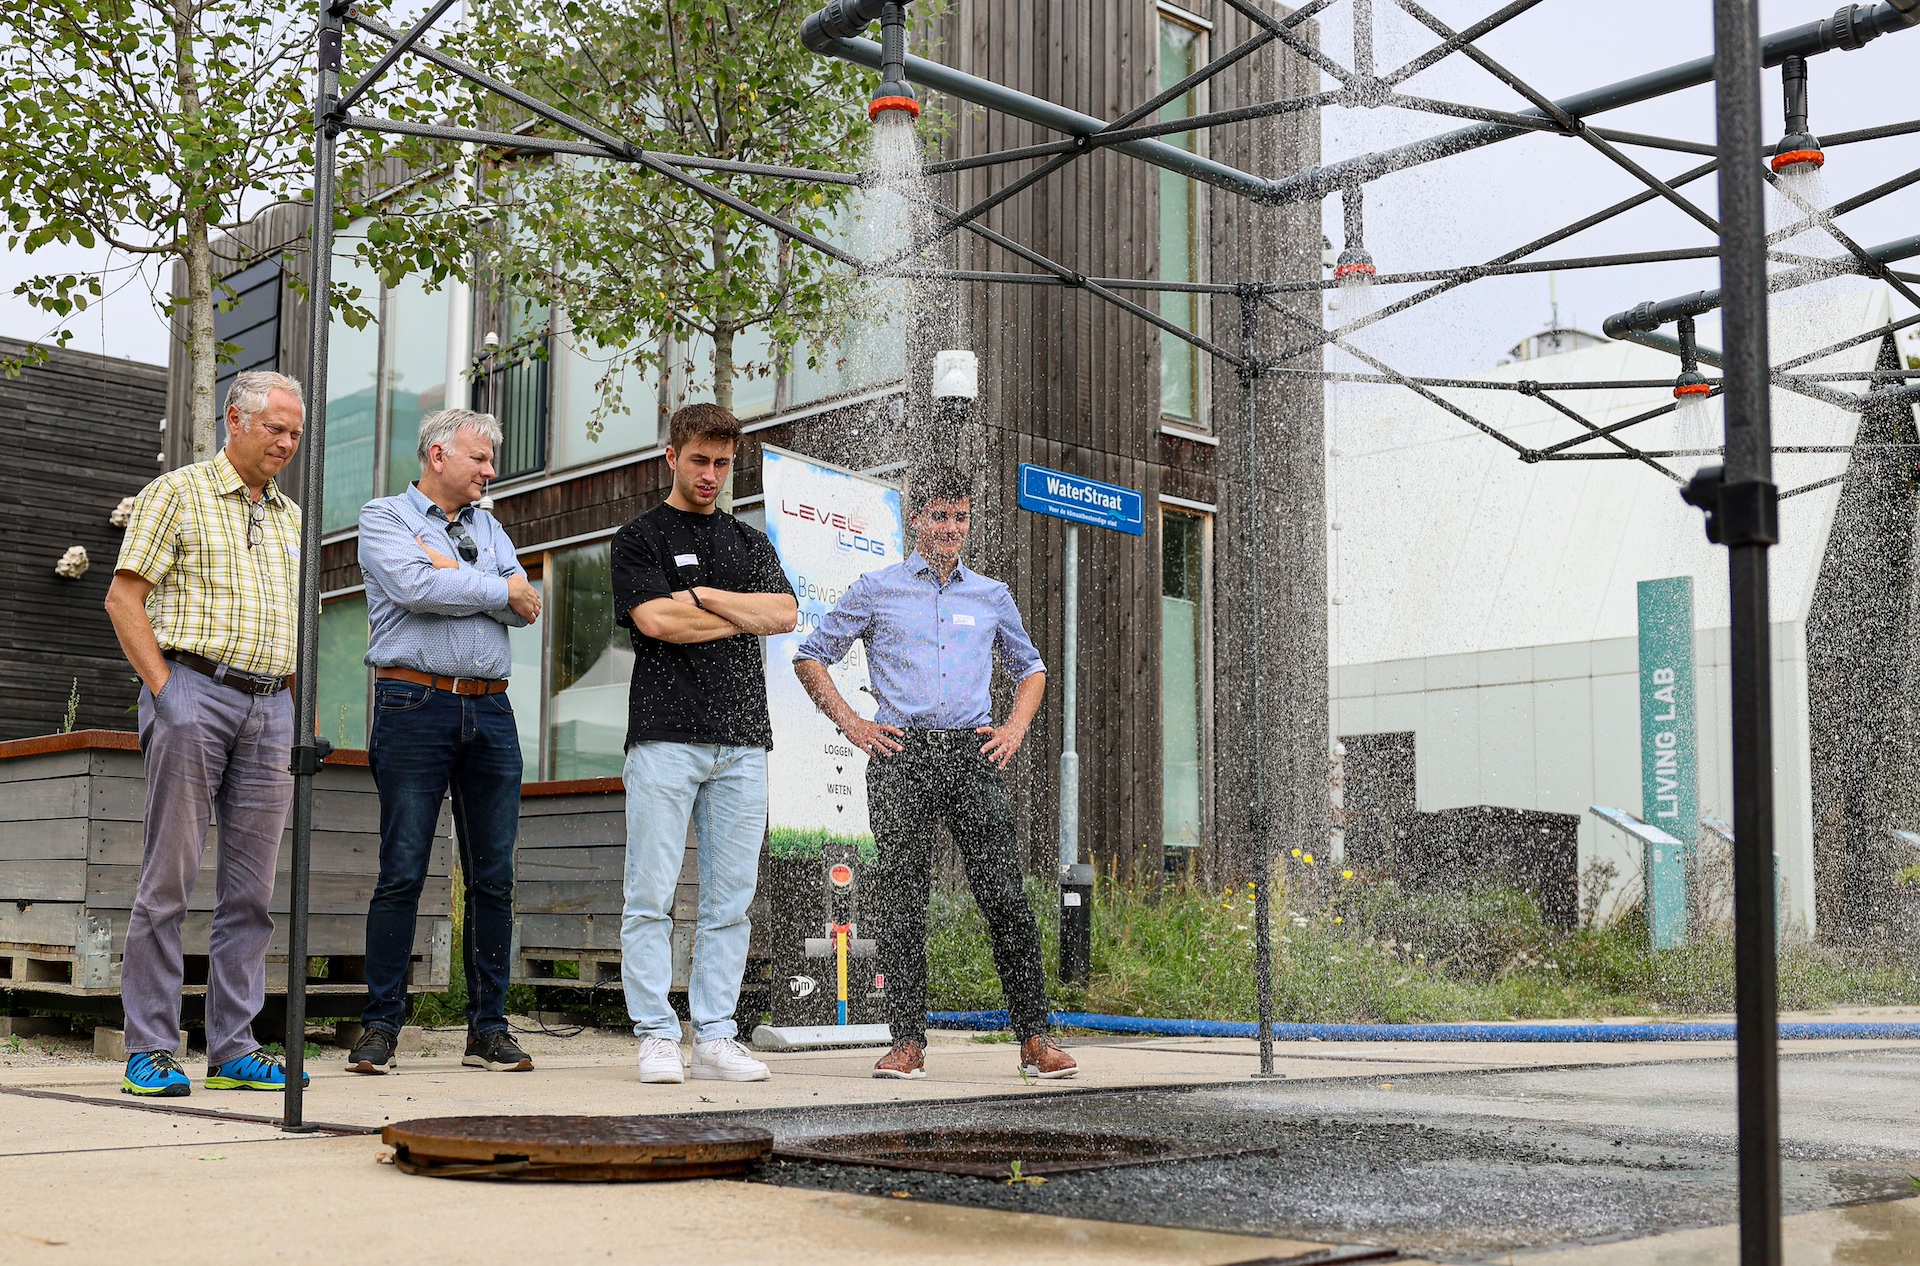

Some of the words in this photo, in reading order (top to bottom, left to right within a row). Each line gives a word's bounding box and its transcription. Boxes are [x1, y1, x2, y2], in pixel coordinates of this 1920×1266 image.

[1046, 476, 1122, 511] WaterStraat
[782, 499, 863, 535] LEVEL
[837, 531, 885, 557] LOG
[1653, 667, 1676, 721] LAB
[824, 744, 854, 757] LOGGEN
[826, 783, 853, 796] WETEN
[1655, 731, 1679, 818] LIVING
